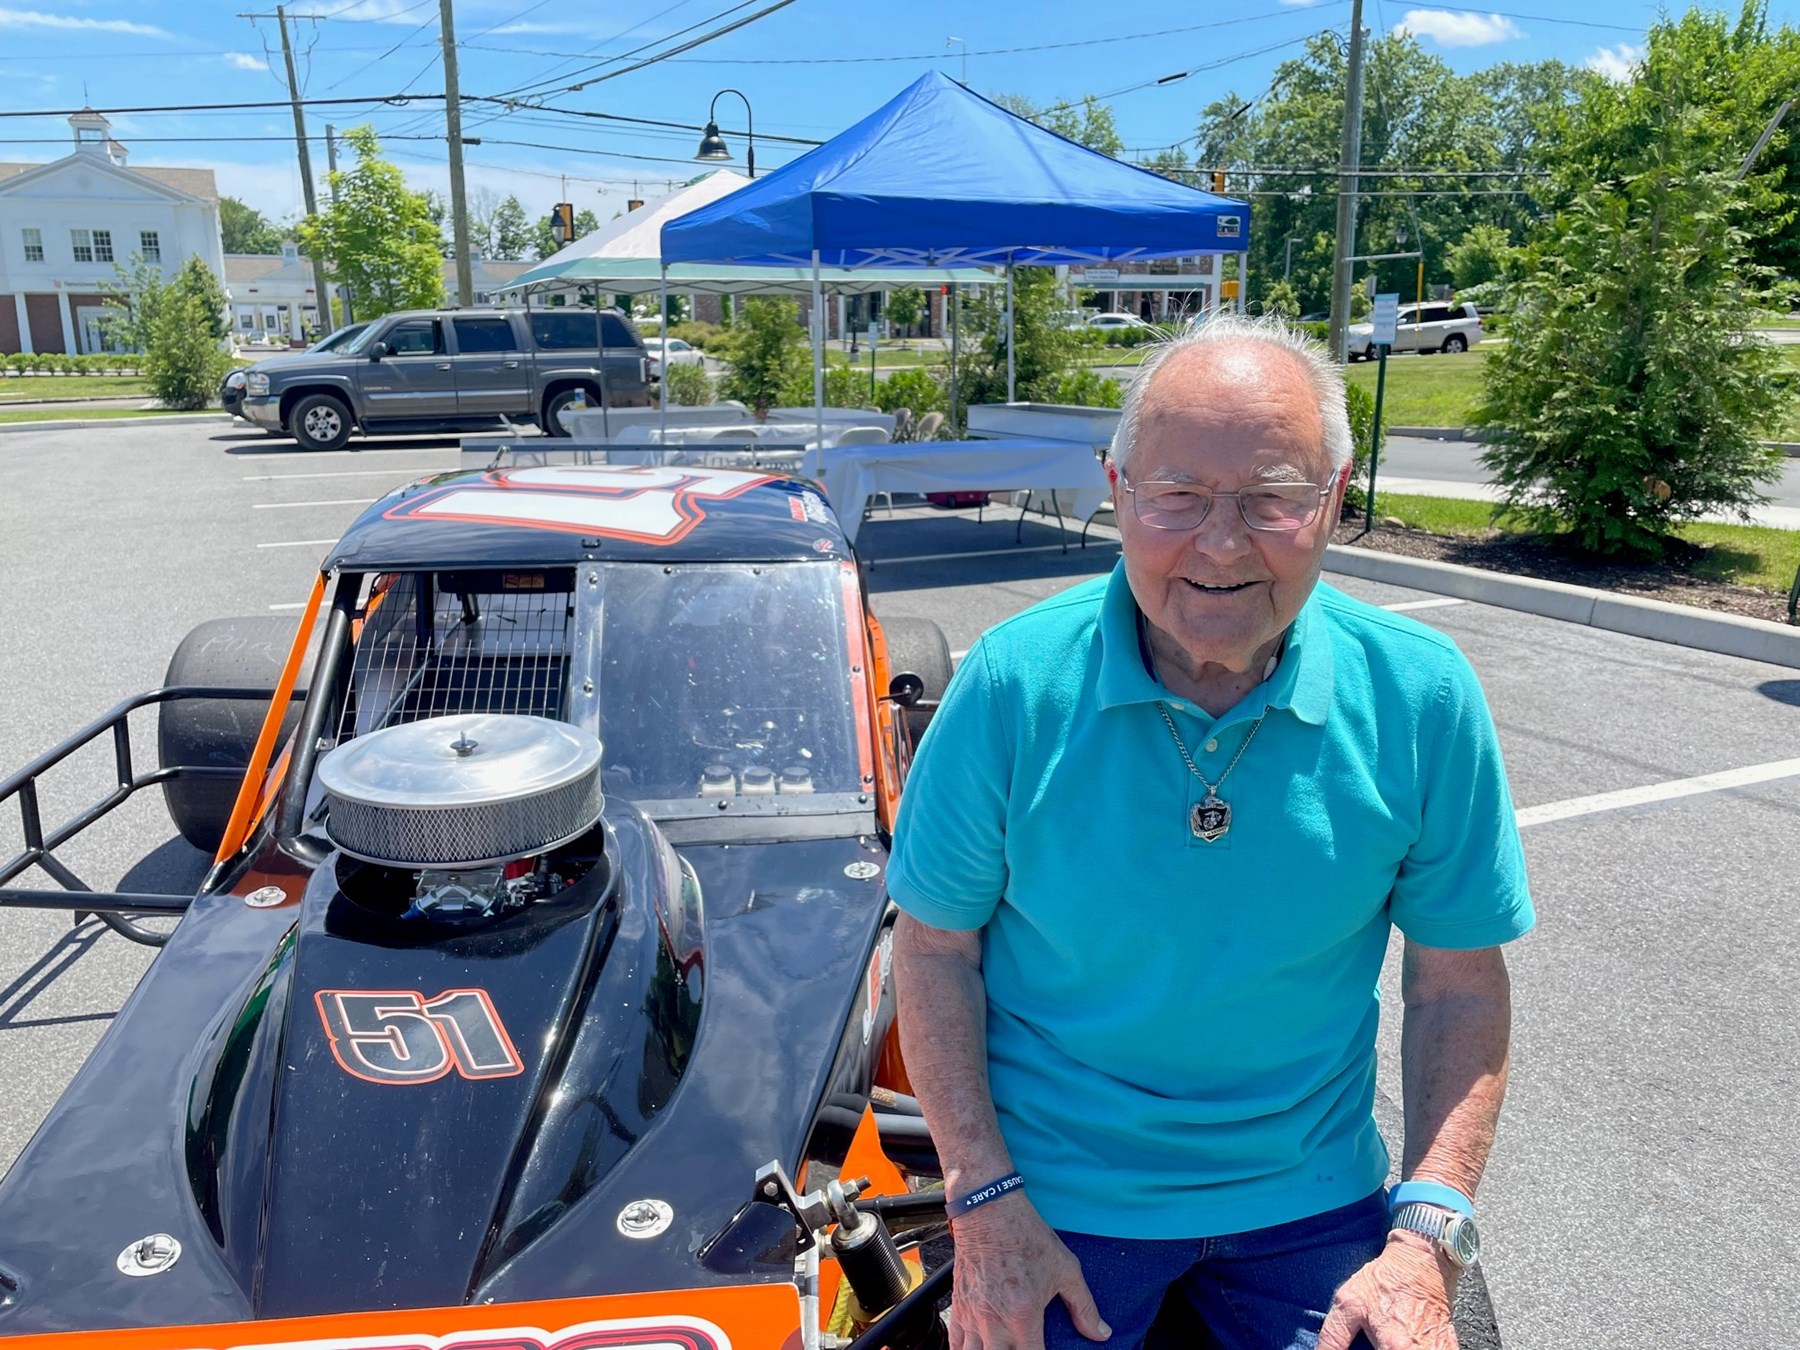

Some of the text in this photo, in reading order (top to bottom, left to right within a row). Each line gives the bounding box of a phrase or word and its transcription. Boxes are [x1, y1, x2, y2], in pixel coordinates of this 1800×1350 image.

[315, 989, 524, 1084] 51
[971, 1187, 996, 1204] CARE
[996, 1184, 1002, 1192] I
